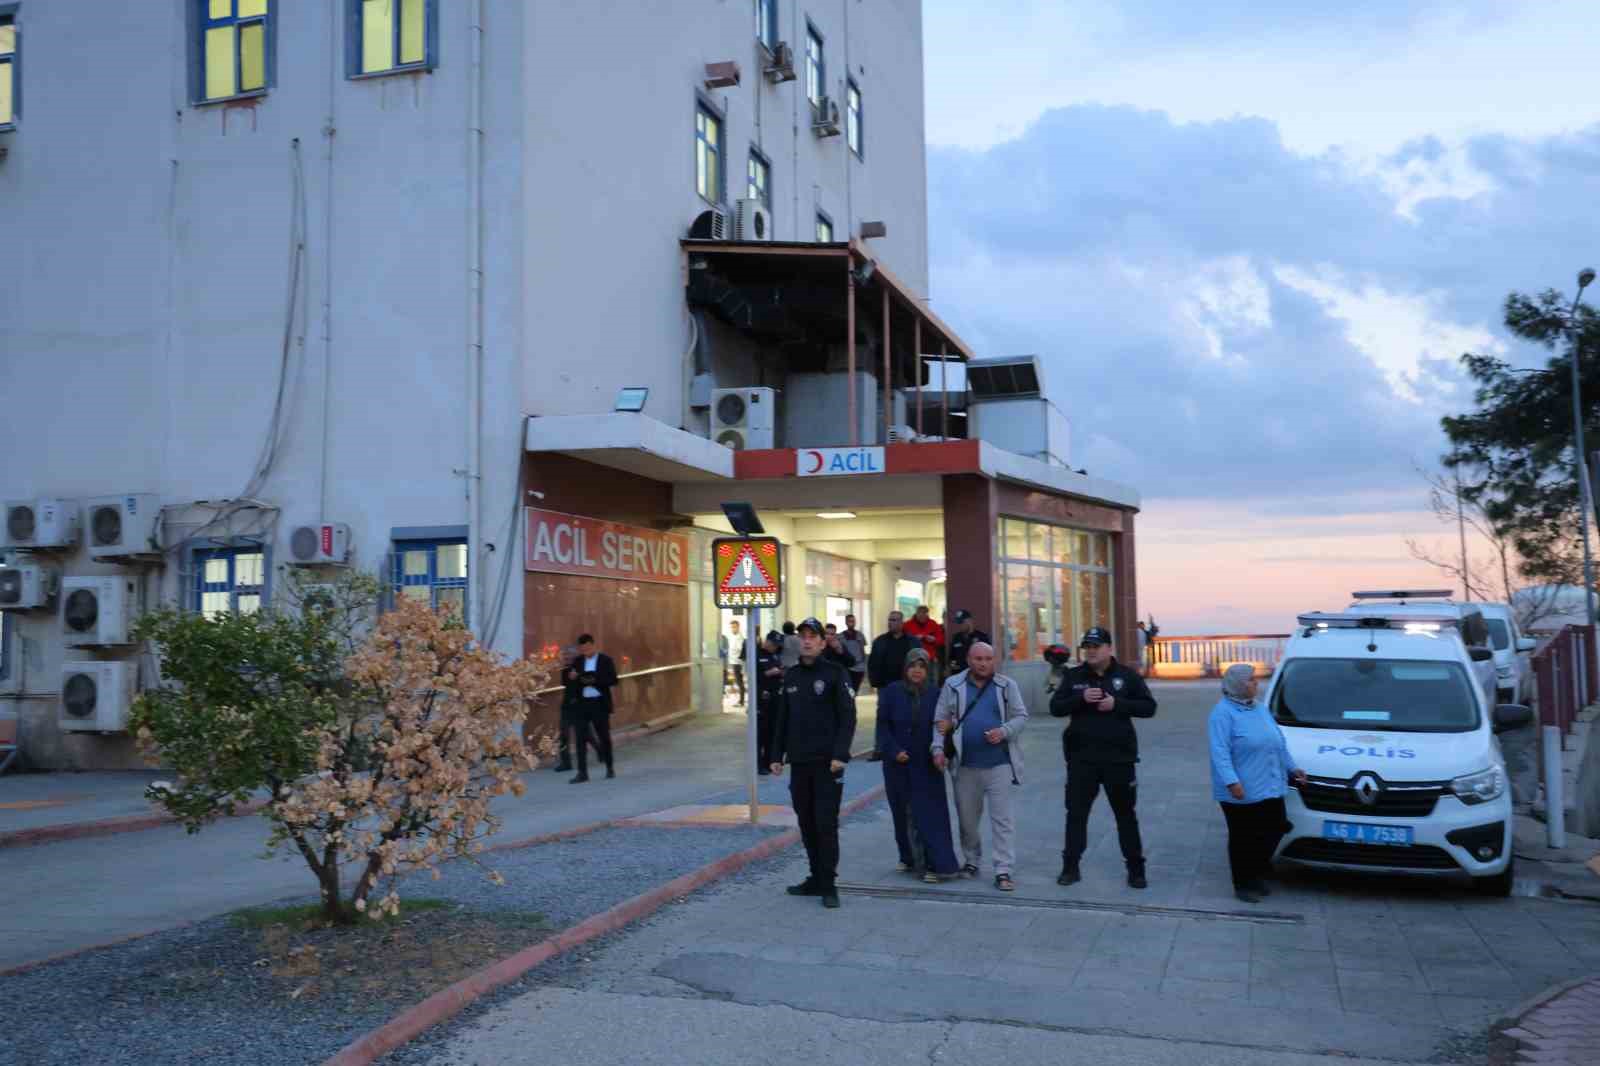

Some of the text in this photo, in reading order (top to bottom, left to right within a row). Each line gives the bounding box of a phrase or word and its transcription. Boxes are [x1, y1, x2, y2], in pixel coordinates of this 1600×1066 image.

[829, 448, 878, 471] ACİL
[533, 519, 682, 577] ACİL SERVİS
[1317, 745, 1417, 759] POLİS
